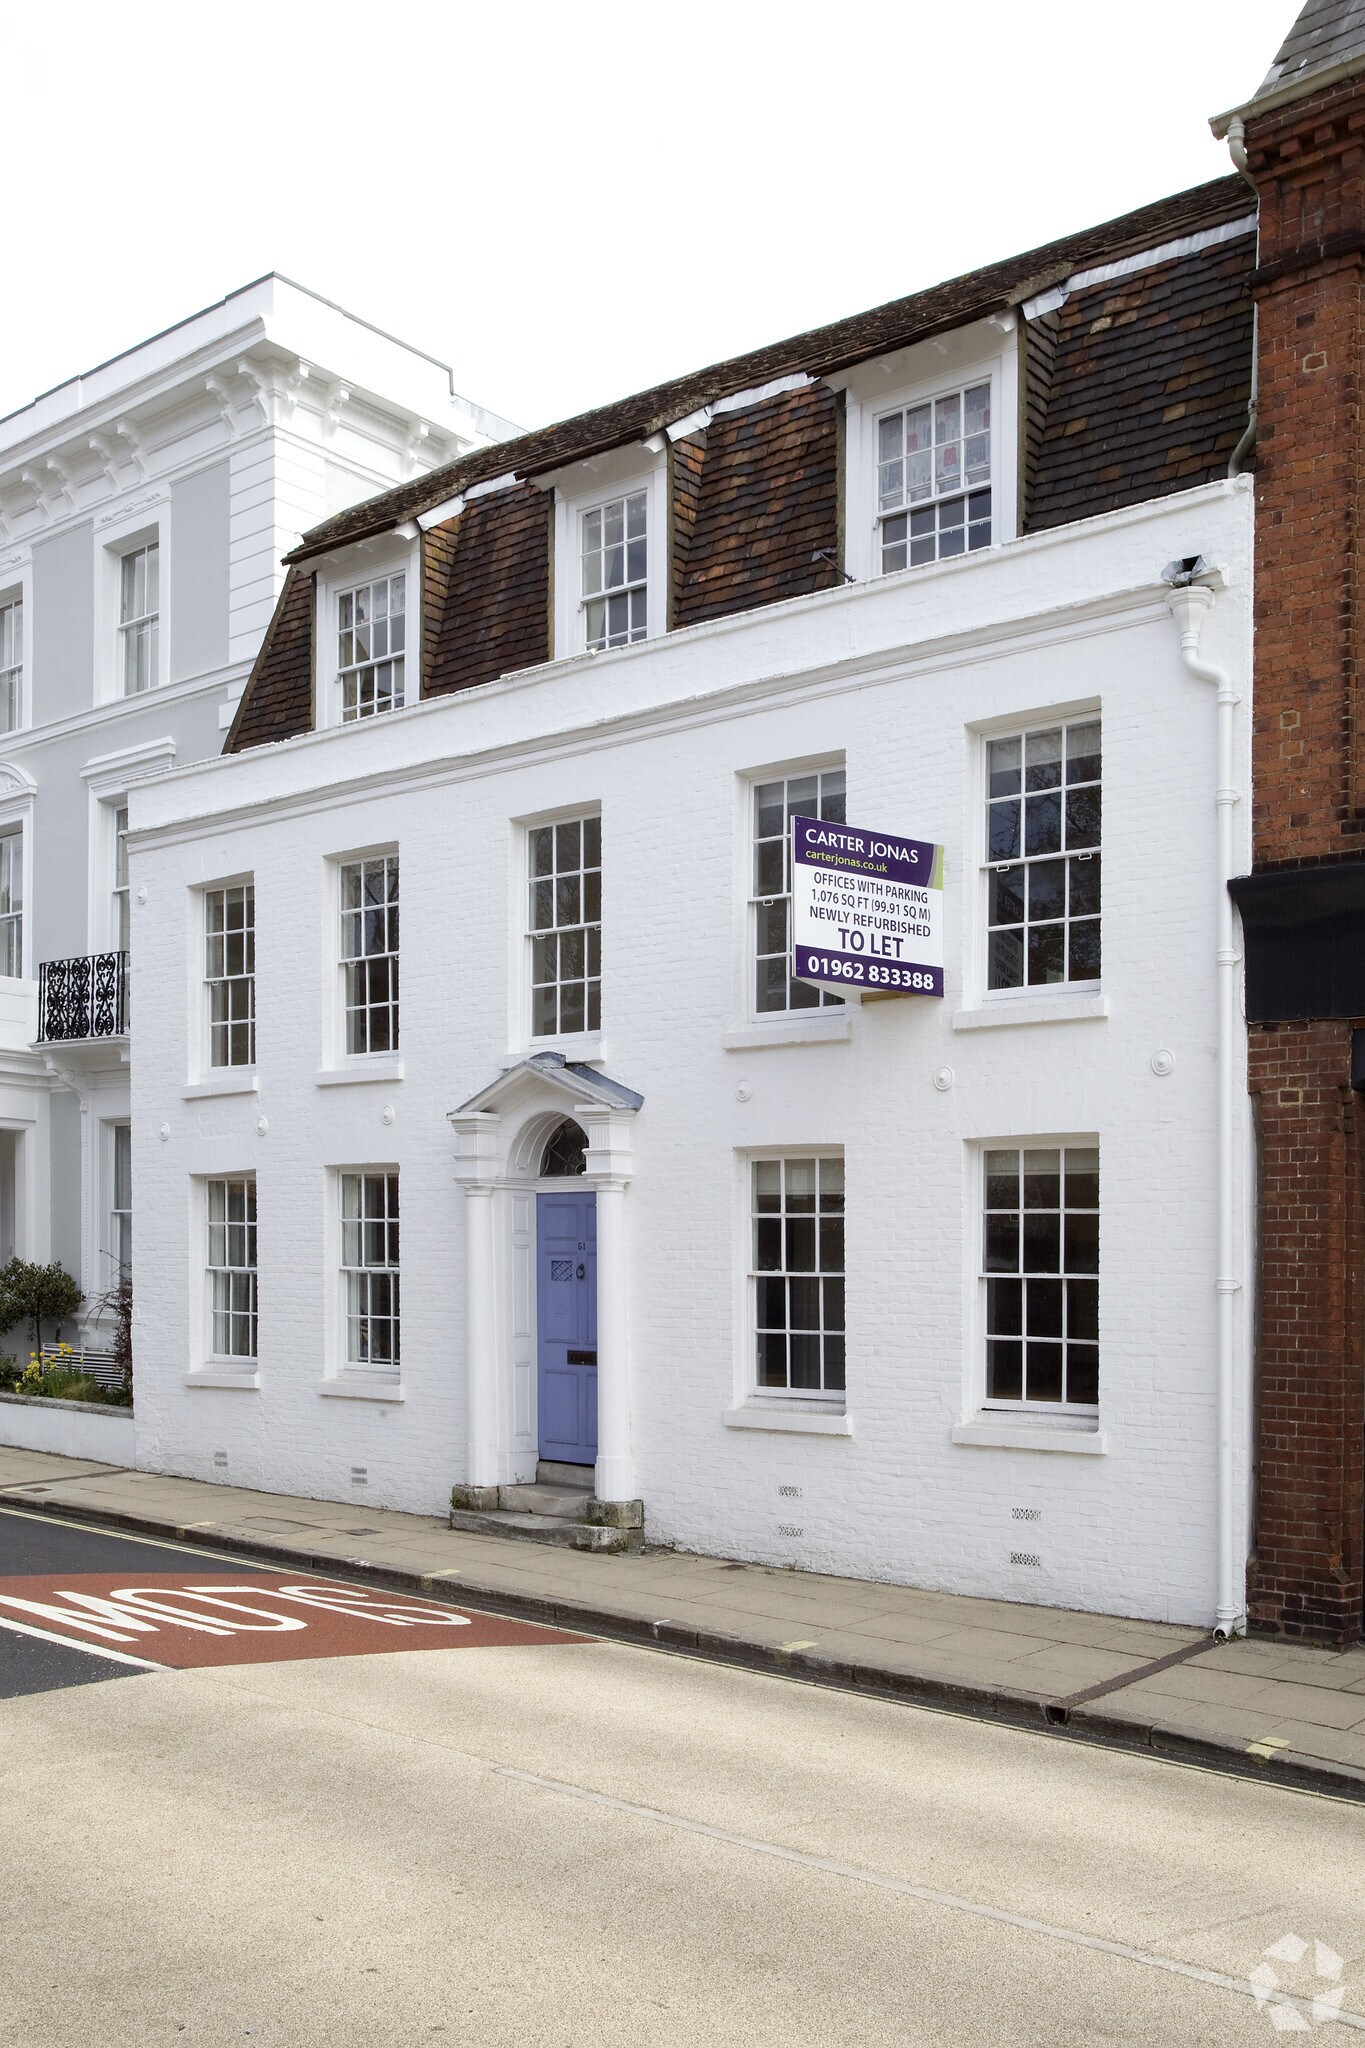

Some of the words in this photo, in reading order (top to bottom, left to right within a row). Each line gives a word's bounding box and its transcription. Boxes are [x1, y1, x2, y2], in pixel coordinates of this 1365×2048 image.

[806, 829, 865, 853] CARTER
[868, 841, 919, 864] JONAS
[806, 850, 888, 873] carterjonas.co.uk
[814, 872, 855, 890] OFFICES
[857, 880, 883, 896] WITH
[885, 885, 928, 904] PARKING
[810, 905, 850, 924] NEWLY
[853, 913, 931, 937] REFURBISHED
[812, 889, 839, 904] 1,076
[841, 893, 855, 909] SQ
[857, 896, 869, 909] FT
[871, 899, 900, 916] (99.91
[903, 905, 917, 920] SQ
[918, 907, 931, 922] M)
[838, 927, 865, 952] TO
[870, 933, 904, 958] LET
[808, 955, 864, 980] 01962
[868, 965, 934, 990] 833388
